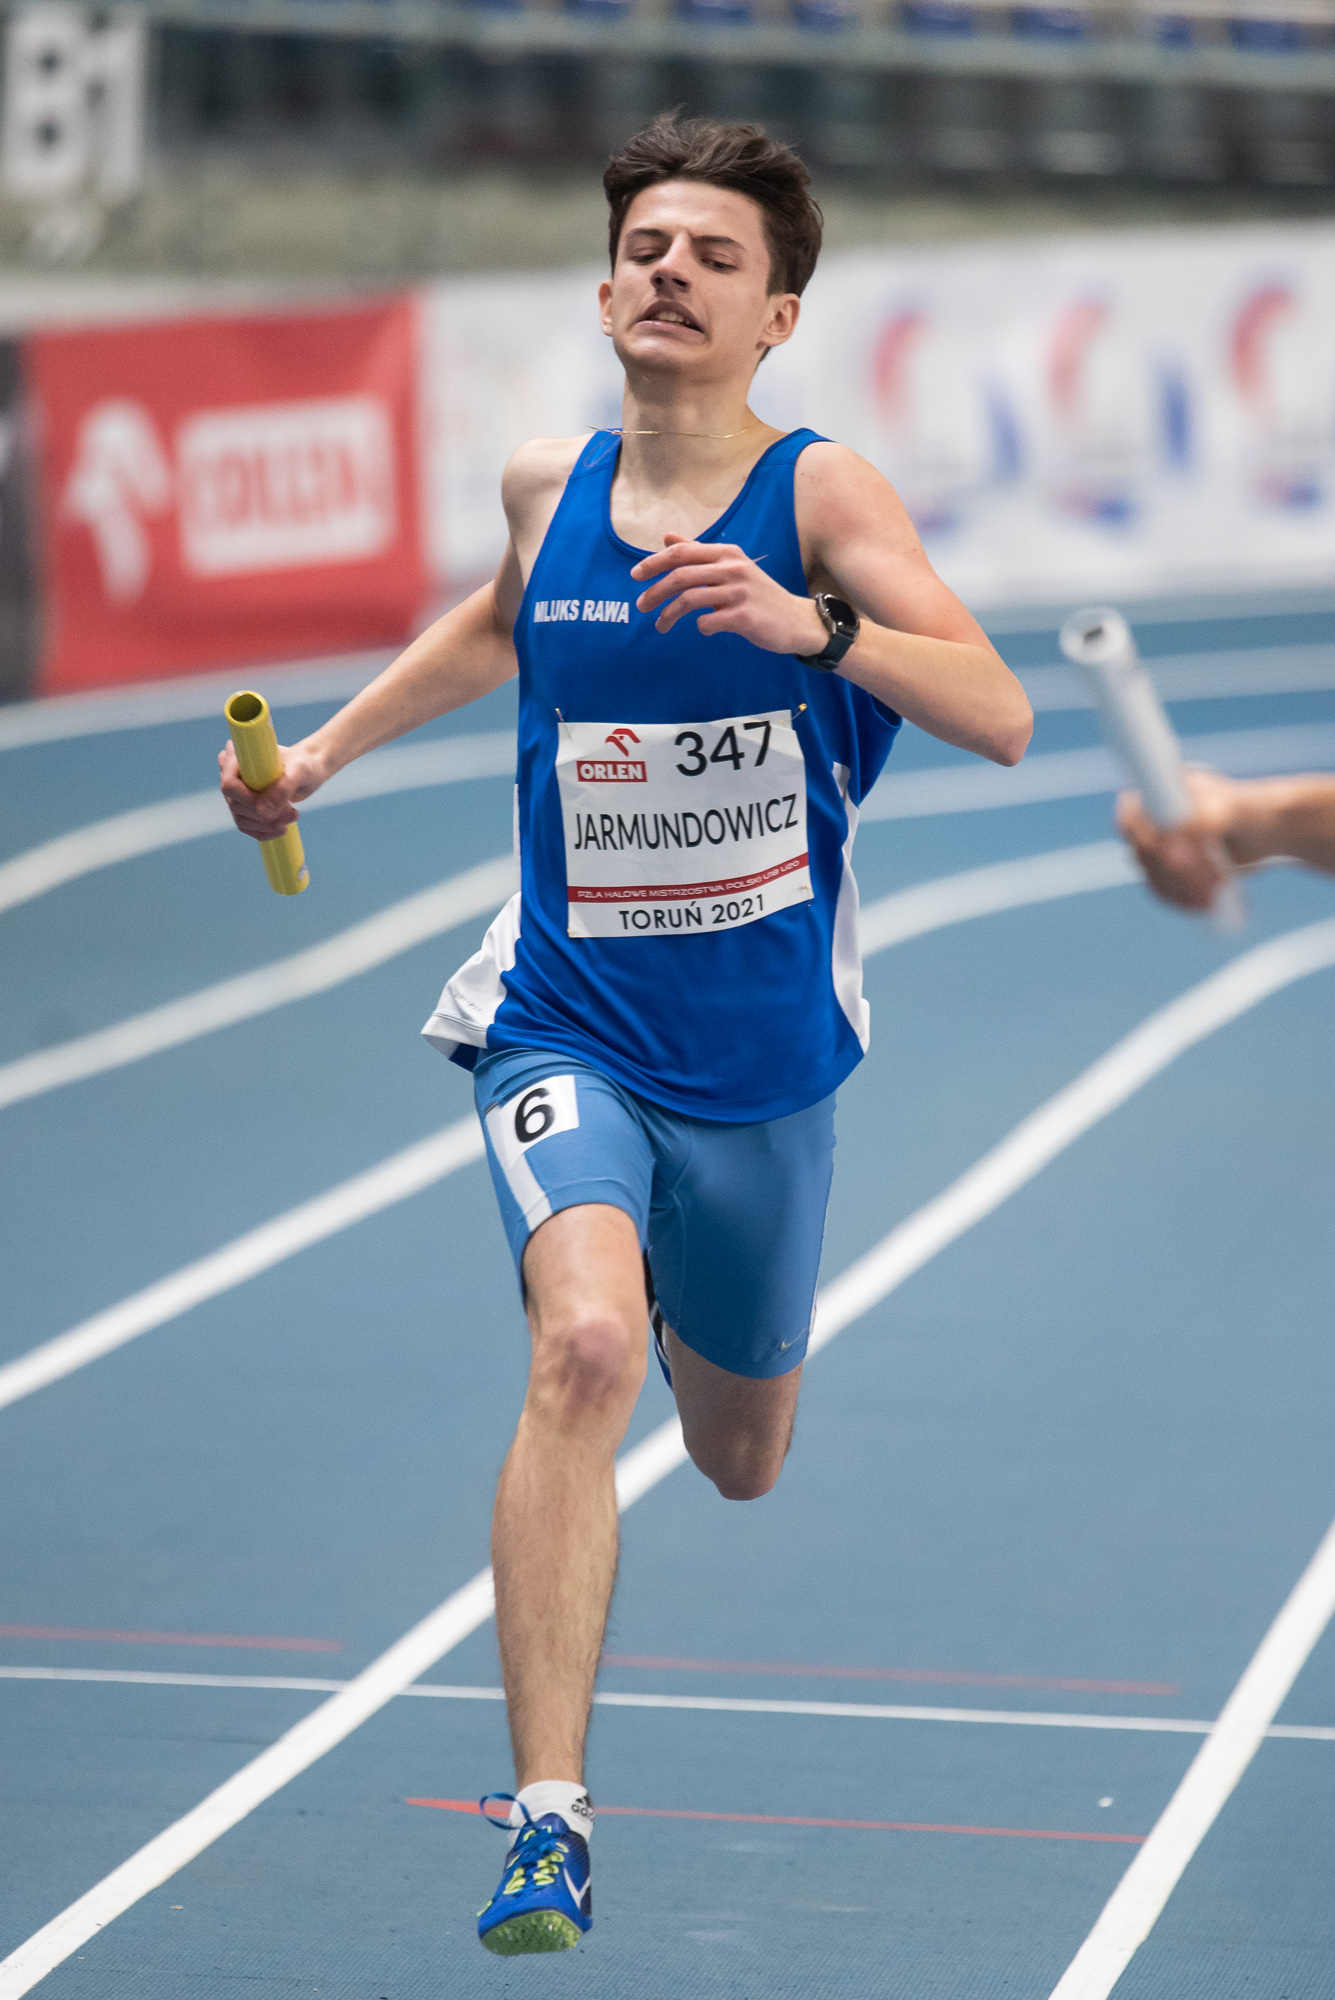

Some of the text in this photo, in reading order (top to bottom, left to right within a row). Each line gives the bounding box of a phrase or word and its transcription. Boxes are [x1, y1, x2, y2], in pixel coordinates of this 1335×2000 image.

[533, 599, 629, 624] MLUKS RAWA
[674, 720, 772, 777] 347
[579, 764, 643, 780] ORLEN
[574, 793, 798, 850] JARMUNDOWICZ
[577, 890, 603, 899] PZLA
[604, 890, 647, 898] HALOWE
[648, 884, 725, 898] MISTRZOSTWA
[726, 876, 762, 890] POLSKI
[780, 860, 800, 872] U20
[619, 894, 764, 930] TORUŃ 2021
[514, 1087, 555, 1143] 6
